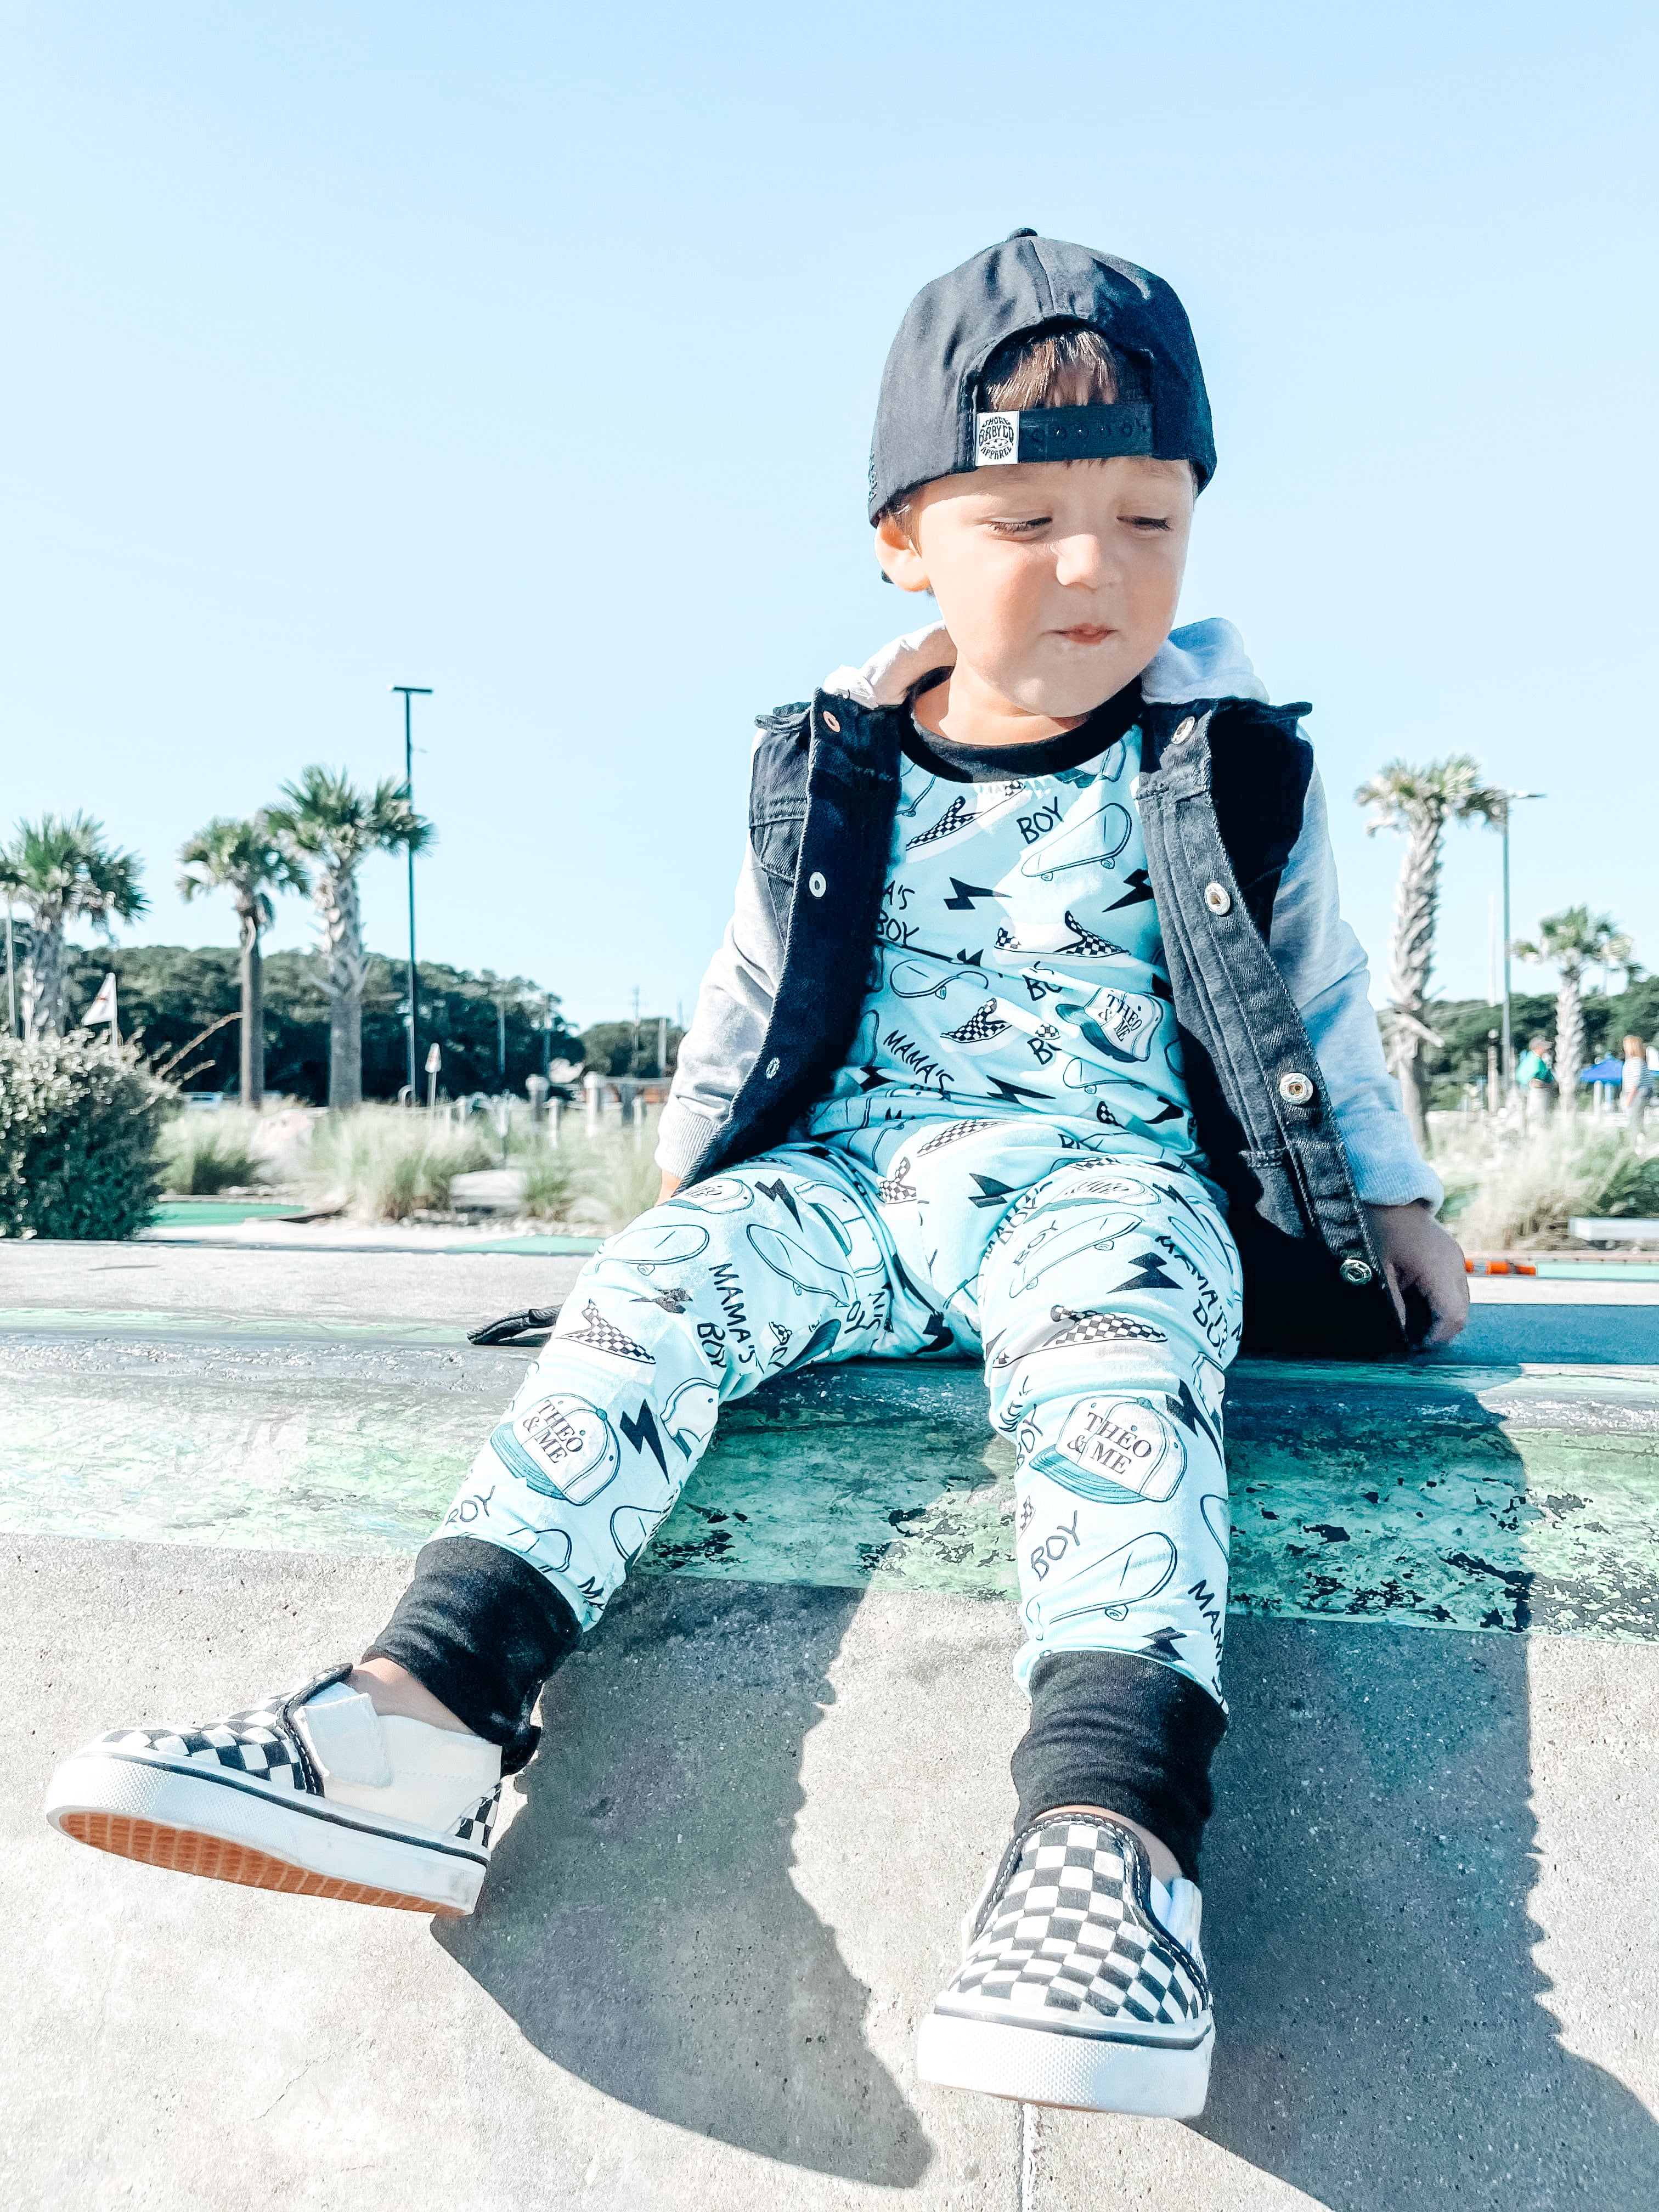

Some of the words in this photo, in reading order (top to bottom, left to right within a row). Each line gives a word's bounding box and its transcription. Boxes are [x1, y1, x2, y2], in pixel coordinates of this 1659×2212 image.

[981, 416, 1011, 427] SHORE
[980, 446, 1012, 460] APPAREL
[1016, 796, 1064, 844] BOY
[1098, 1008, 1112, 1023] &
[1106, 994, 1142, 1031] THEO
[883, 1030, 955, 1092] MAMA'S
[1013, 1220, 1058, 1266] BOY
[708, 1263, 756, 1363] MAMA'S
[697, 1322, 727, 1368] BOY
[522, 1416, 540, 1433] &
[533, 1429, 568, 1464] ME
[537, 1399, 583, 1452] THEO
[1084, 1412, 1152, 1458] THEO
[1066, 1435, 1086, 1454] &
[1089, 1441, 1132, 1474] ME
[1031, 1509, 1080, 1582] BOY
